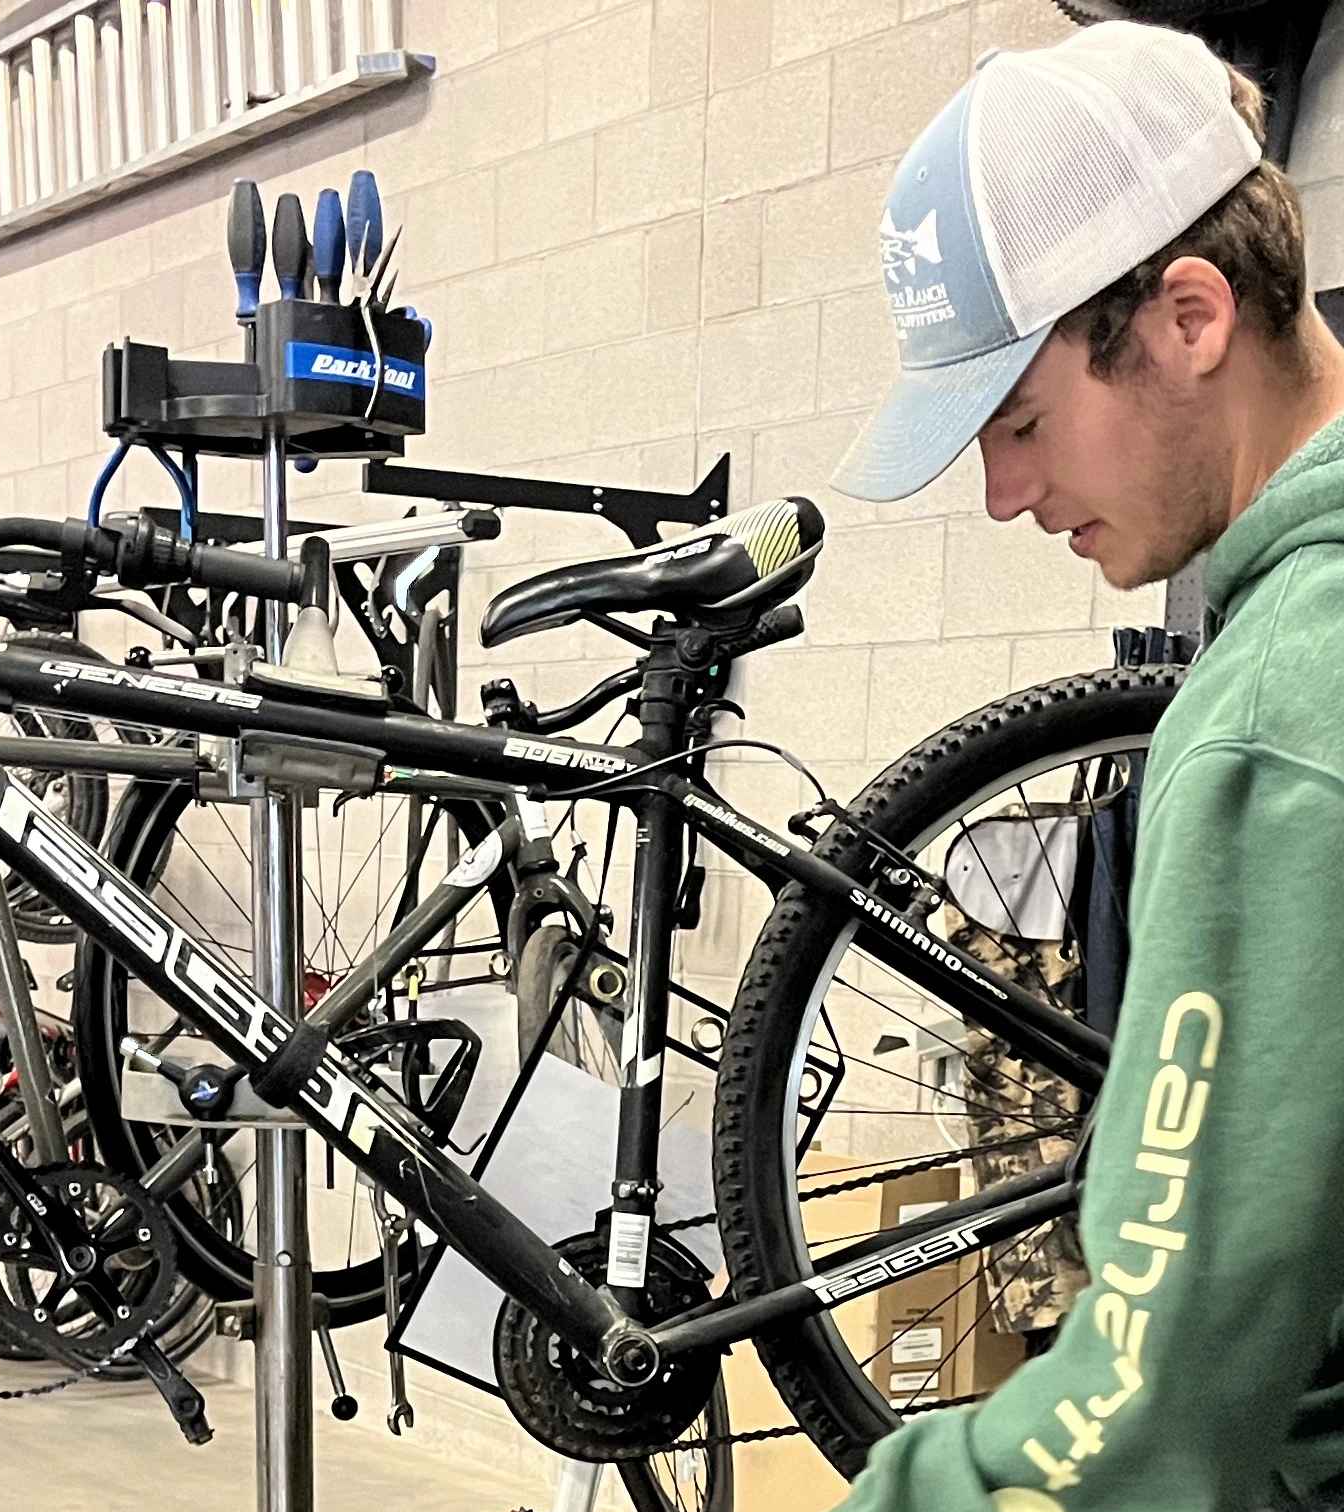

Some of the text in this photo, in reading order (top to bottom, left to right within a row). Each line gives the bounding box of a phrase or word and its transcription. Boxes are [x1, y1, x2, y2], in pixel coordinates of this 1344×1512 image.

[311, 353, 373, 381] Park
[39, 660, 263, 710] GENESIS
[849, 889, 963, 971] SHIMANO
